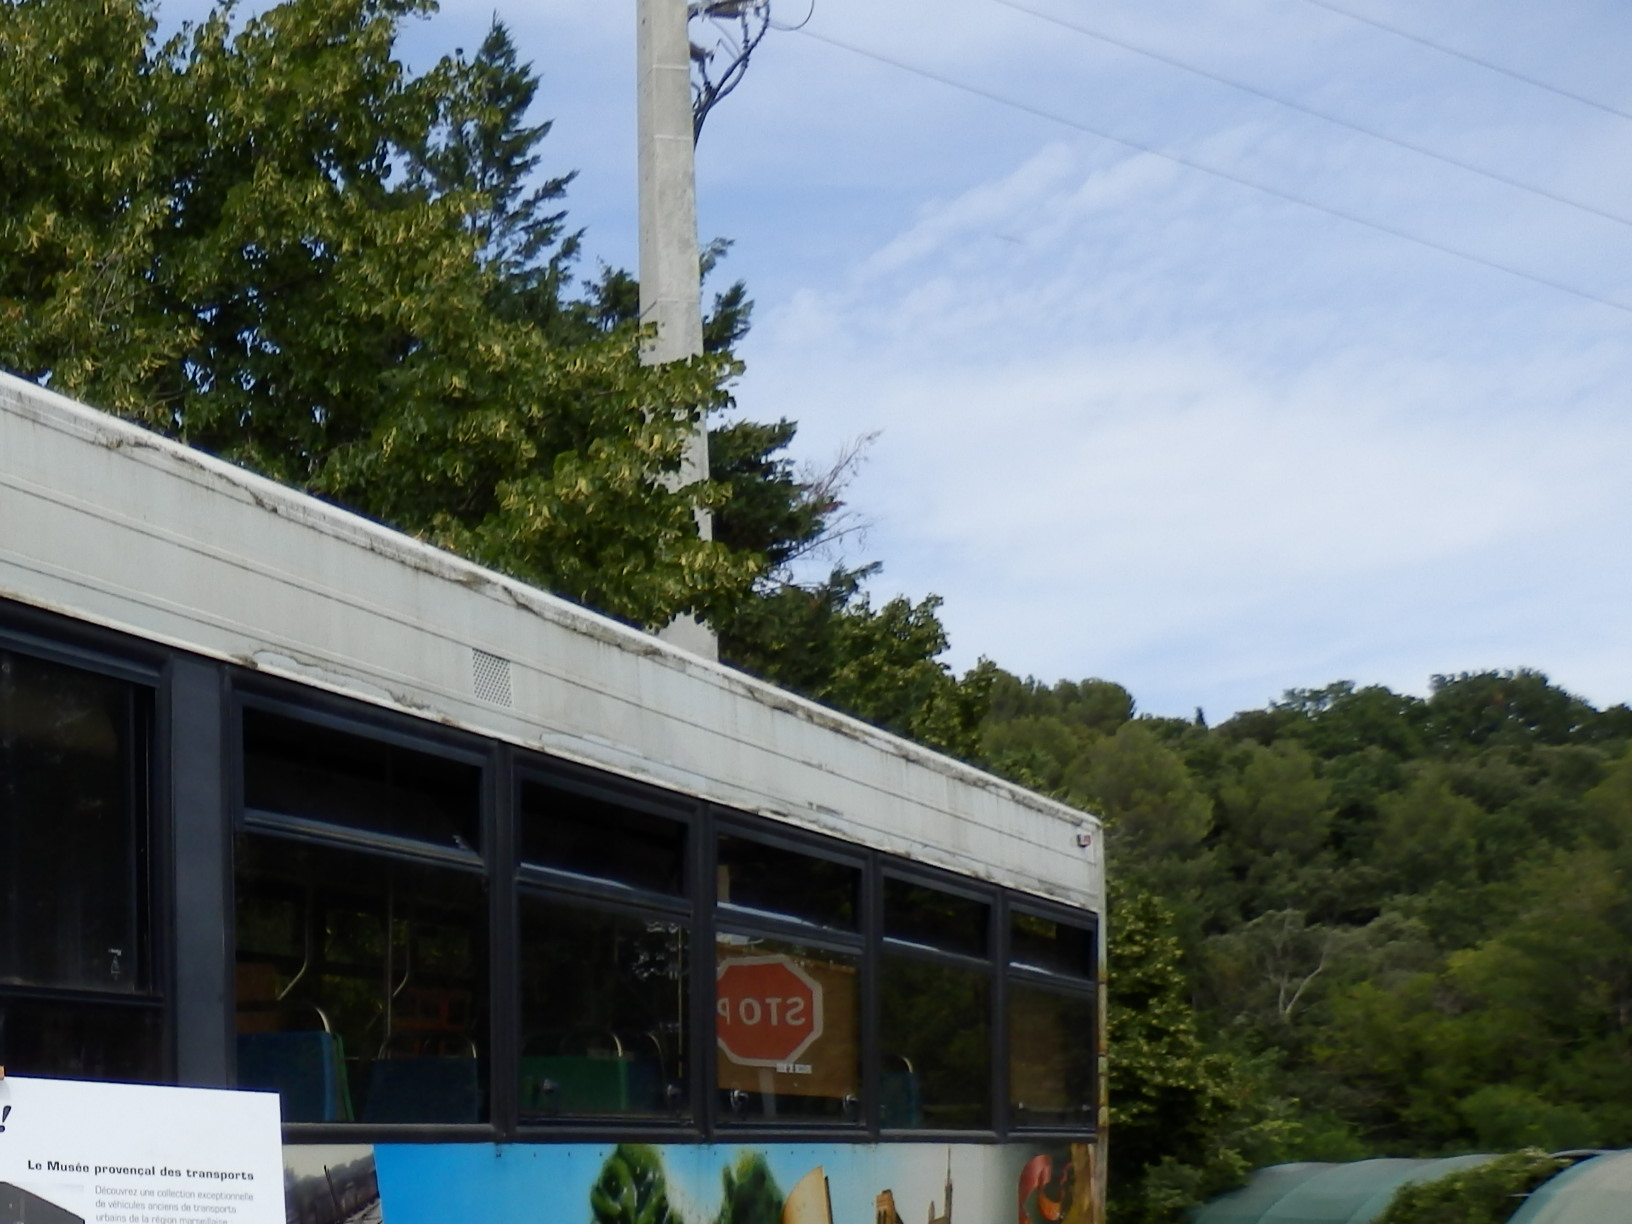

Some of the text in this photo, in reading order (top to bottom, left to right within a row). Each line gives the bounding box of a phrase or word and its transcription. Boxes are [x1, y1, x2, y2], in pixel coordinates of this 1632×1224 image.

[28, 1160, 254, 1182] Le Musée provençal des transports
[95, 1185, 254, 1202] Découvrez une collection exceptionnelle
[95, 1199, 237, 1215] de véhicules anciens de transports
[95, 1213, 127, 1224] urbains
[129, 1214, 140, 1224] de
[141, 1214, 149, 1224] la
